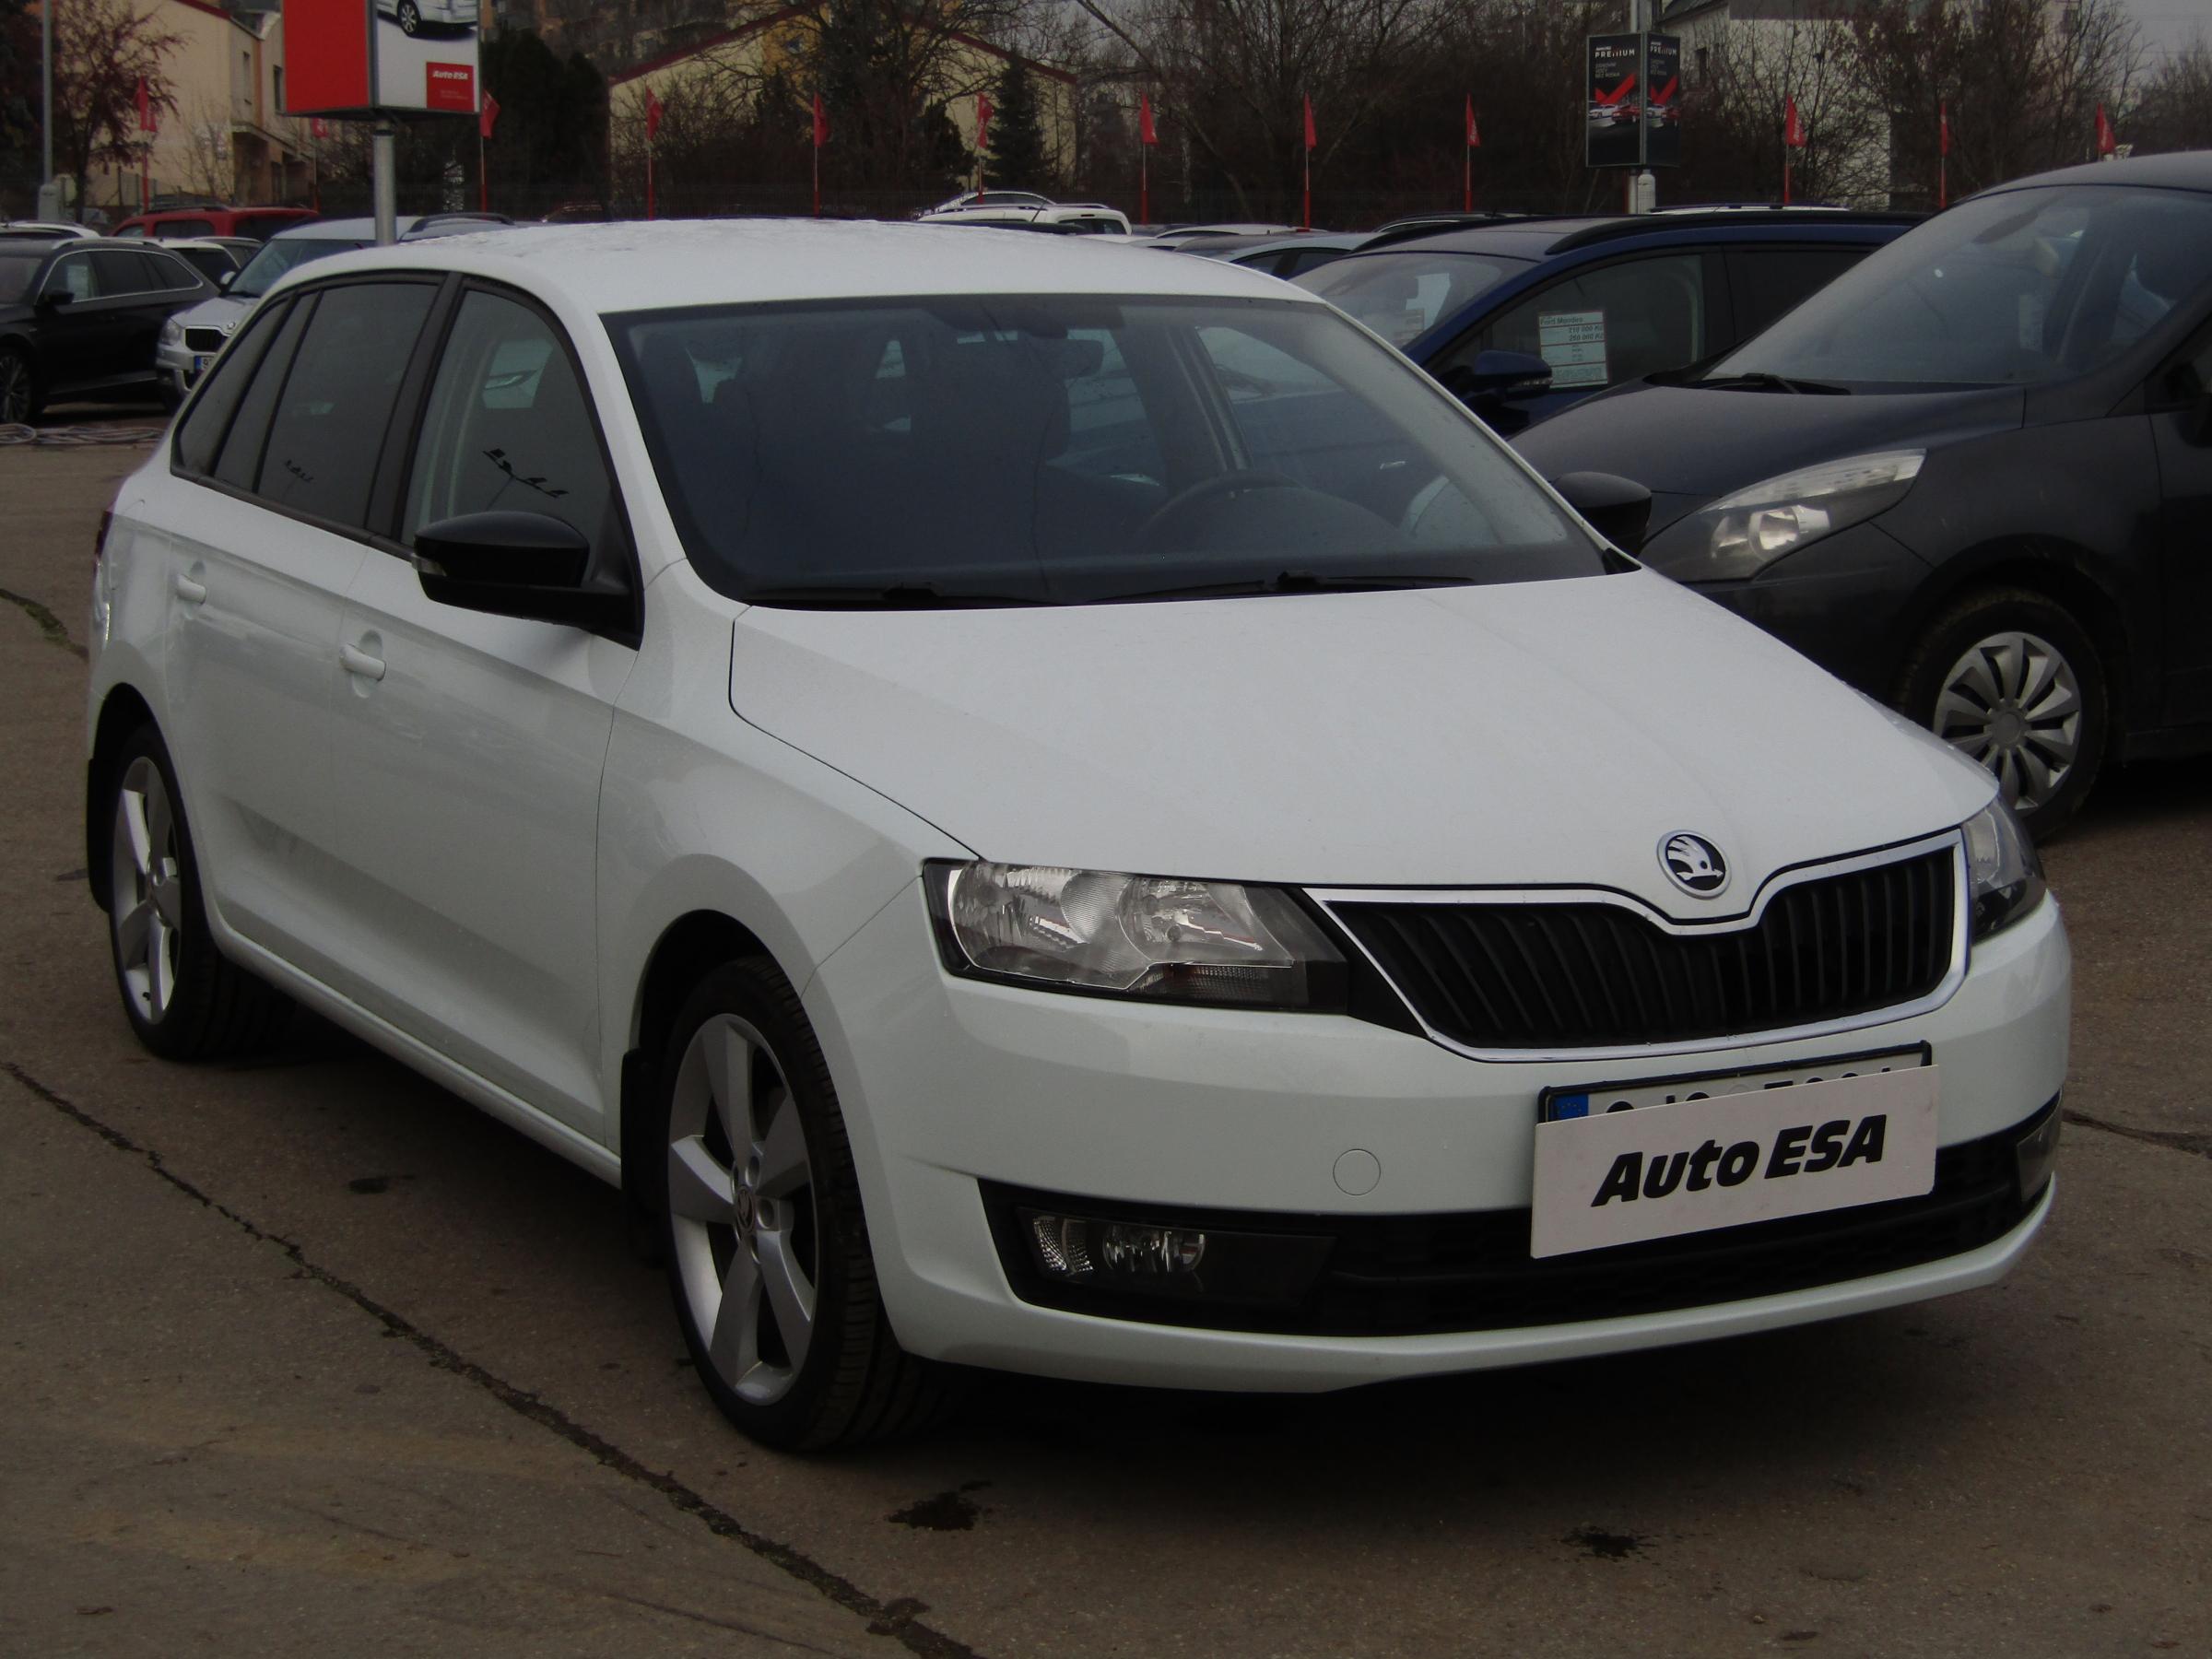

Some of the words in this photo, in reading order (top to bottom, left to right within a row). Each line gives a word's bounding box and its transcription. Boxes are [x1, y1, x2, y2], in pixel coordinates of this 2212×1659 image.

[432, 70, 453, 79] Auto
[1591, 1140, 1759, 1207] Auto
[1764, 1114, 1887, 1179] ESA
